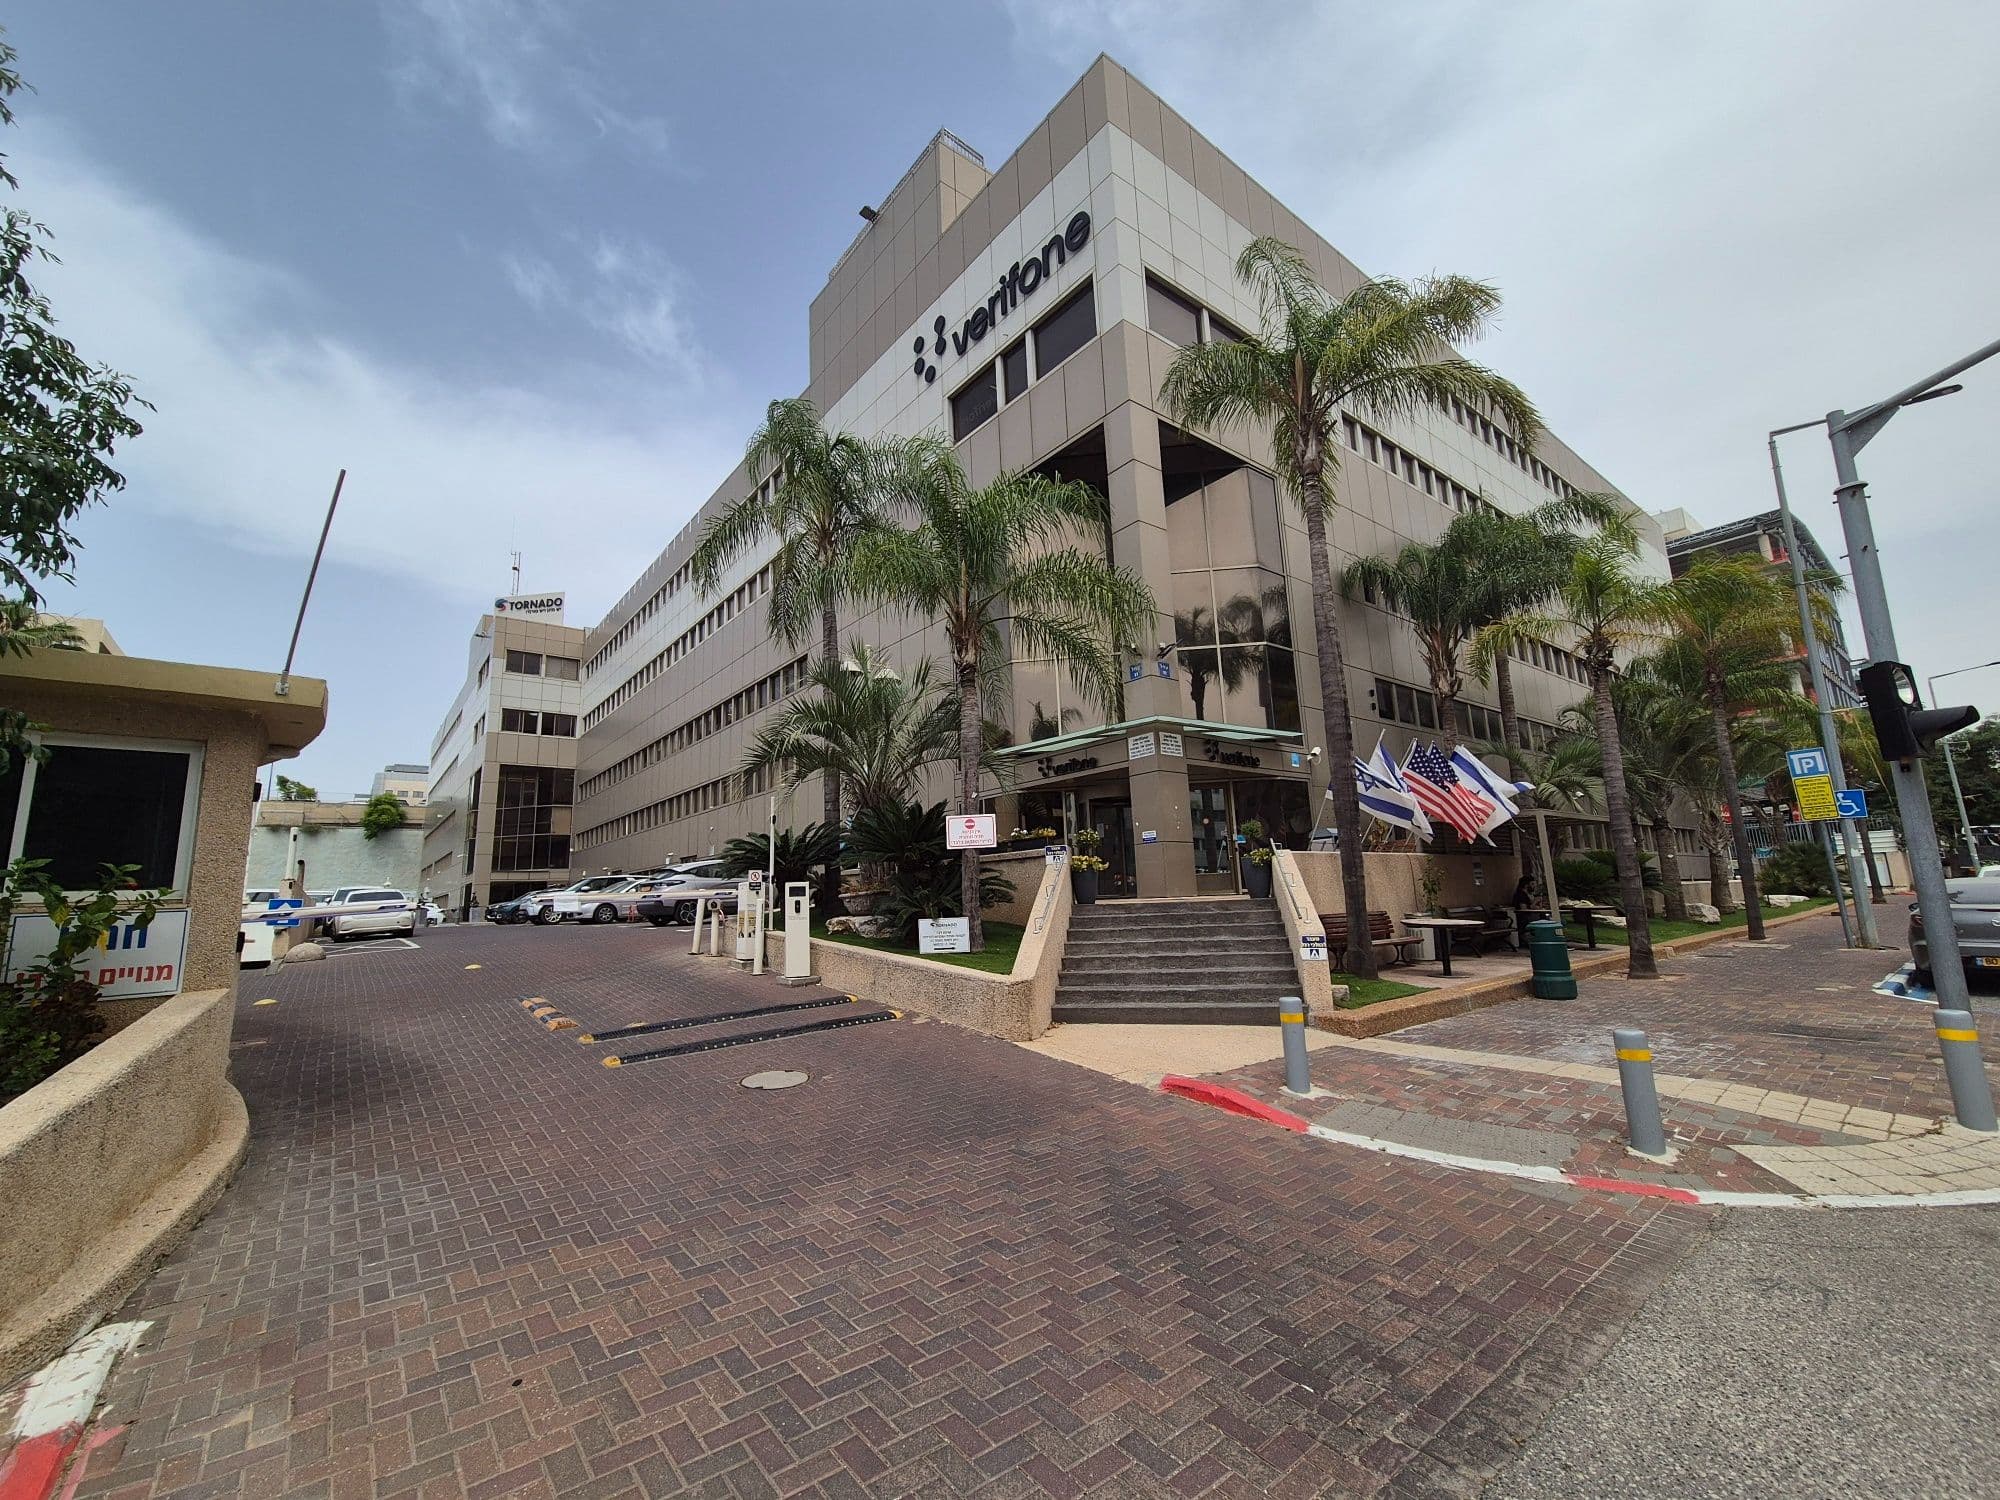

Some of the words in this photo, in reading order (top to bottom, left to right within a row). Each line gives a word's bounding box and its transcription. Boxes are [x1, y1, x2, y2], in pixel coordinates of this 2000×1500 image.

[952, 211, 1091, 356] verifone
[509, 598, 563, 611] TORNADO
[99, 964, 174, 985] מנויים
